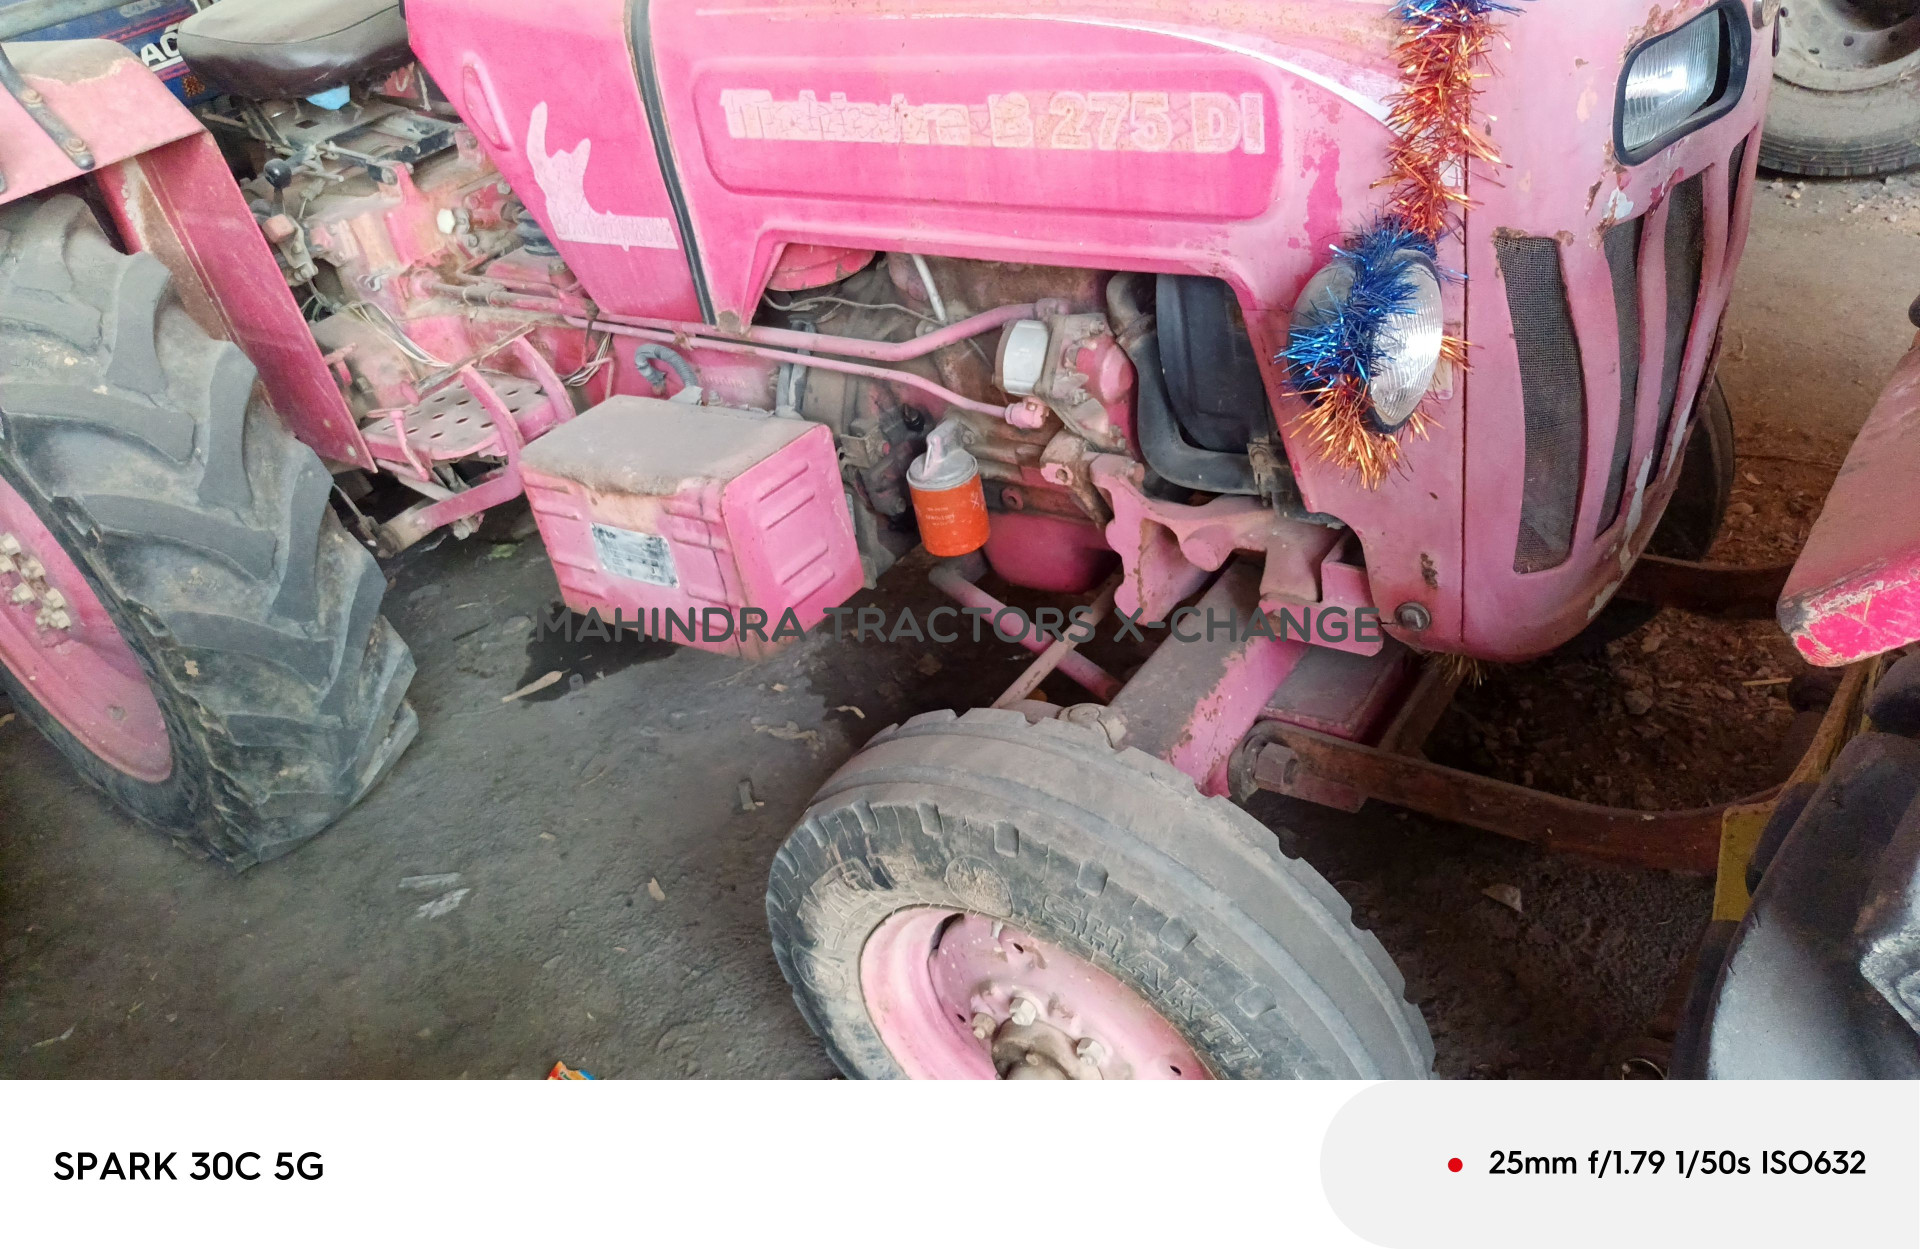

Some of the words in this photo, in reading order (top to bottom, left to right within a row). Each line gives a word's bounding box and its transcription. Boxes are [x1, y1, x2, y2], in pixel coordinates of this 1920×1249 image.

[1048, 90, 1174, 152] 275
[1189, 91, 1266, 155] DI
[1041, 893, 1264, 1065] SHAKTI
